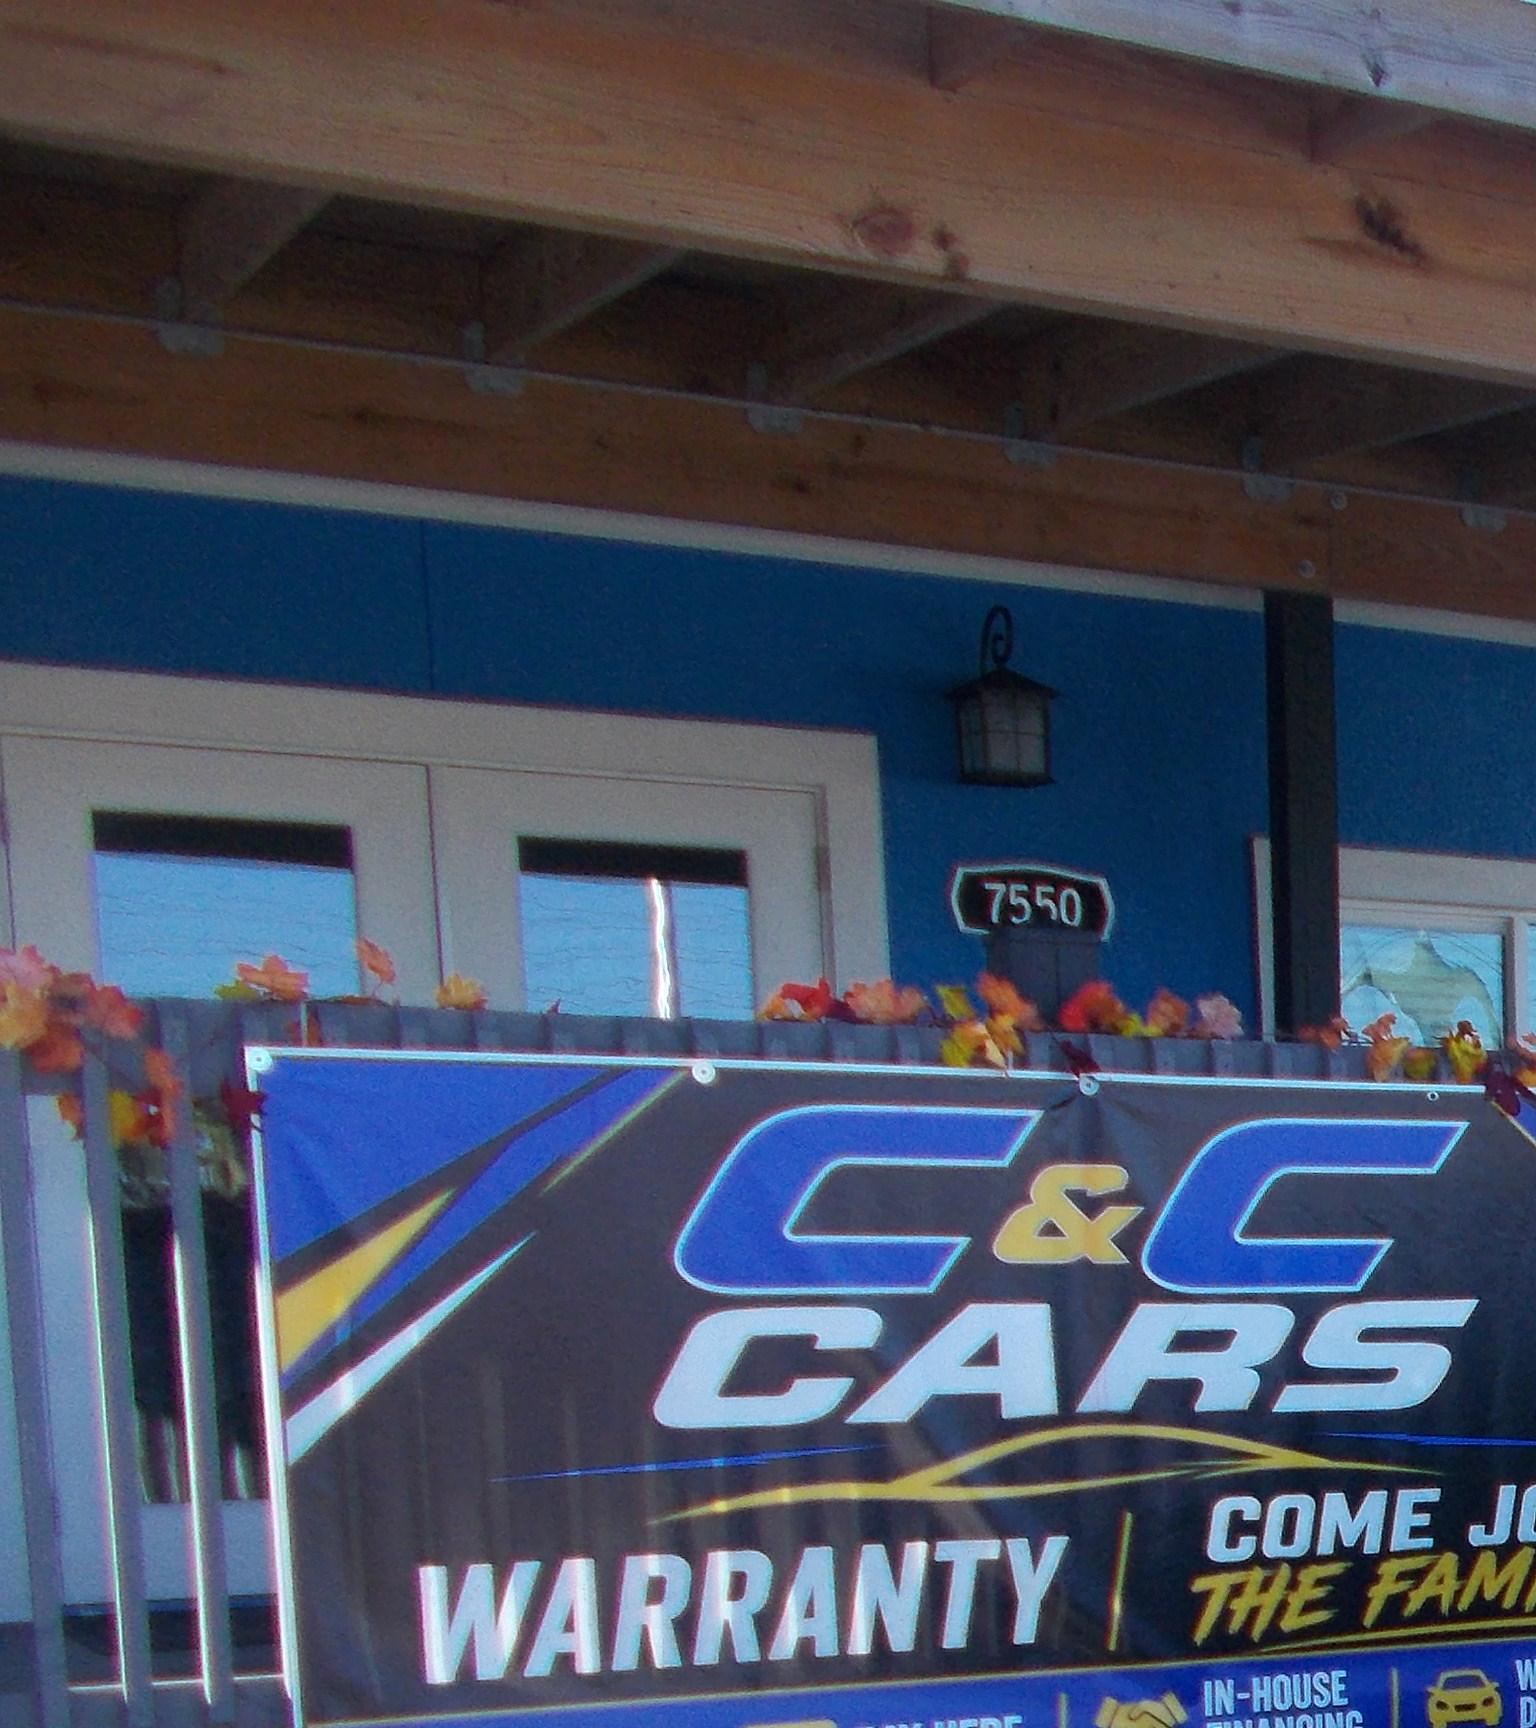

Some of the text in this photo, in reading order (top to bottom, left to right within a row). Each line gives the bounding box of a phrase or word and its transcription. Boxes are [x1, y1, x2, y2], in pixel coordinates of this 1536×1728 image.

[984, 882, 1083, 927] 7550
[673, 1104, 1471, 1294] C&C
[654, 1299, 1480, 1429] CARS
[1206, 1487, 1443, 1564] COME
[418, 1536, 1069, 1685] WARRANTY
[1190, 1560, 1354, 1647] THE
[1203, 1669, 1349, 1717] IN-HOUSE
